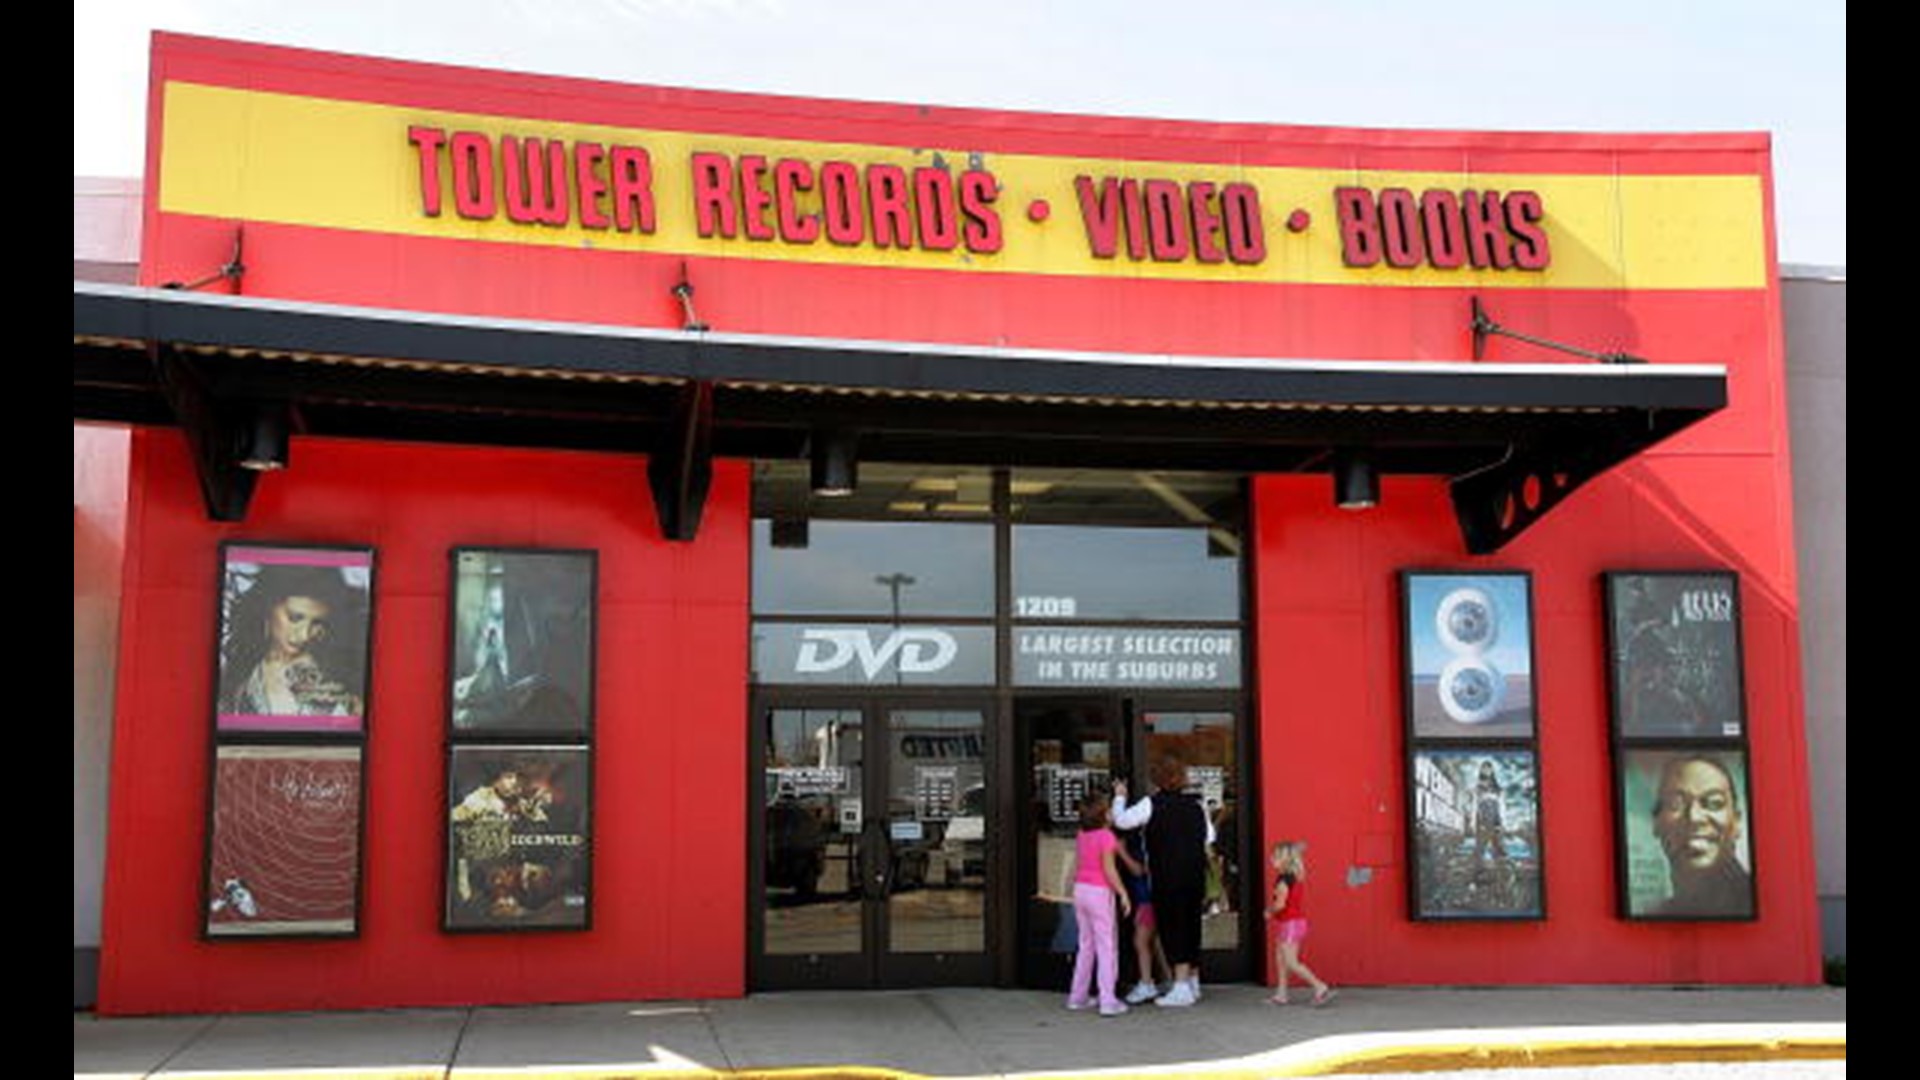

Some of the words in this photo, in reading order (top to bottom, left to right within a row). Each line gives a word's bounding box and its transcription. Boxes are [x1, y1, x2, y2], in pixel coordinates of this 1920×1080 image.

[408, 125, 656, 235] TOWER
[691, 151, 1004, 255] RECORDS
[1074, 175, 1267, 265] VIDEO
[1333, 185, 1552, 271] BOOKS
[1016, 597, 1077, 617] 1209
[795, 628, 958, 680] DVD
[1020, 634, 1115, 654] LARGEST
[1123, 635, 1233, 655] SELECTION
[1038, 661, 1063, 679] IN
[1070, 661, 1109, 680] THE
[1117, 661, 1218, 680] SUBURBS
